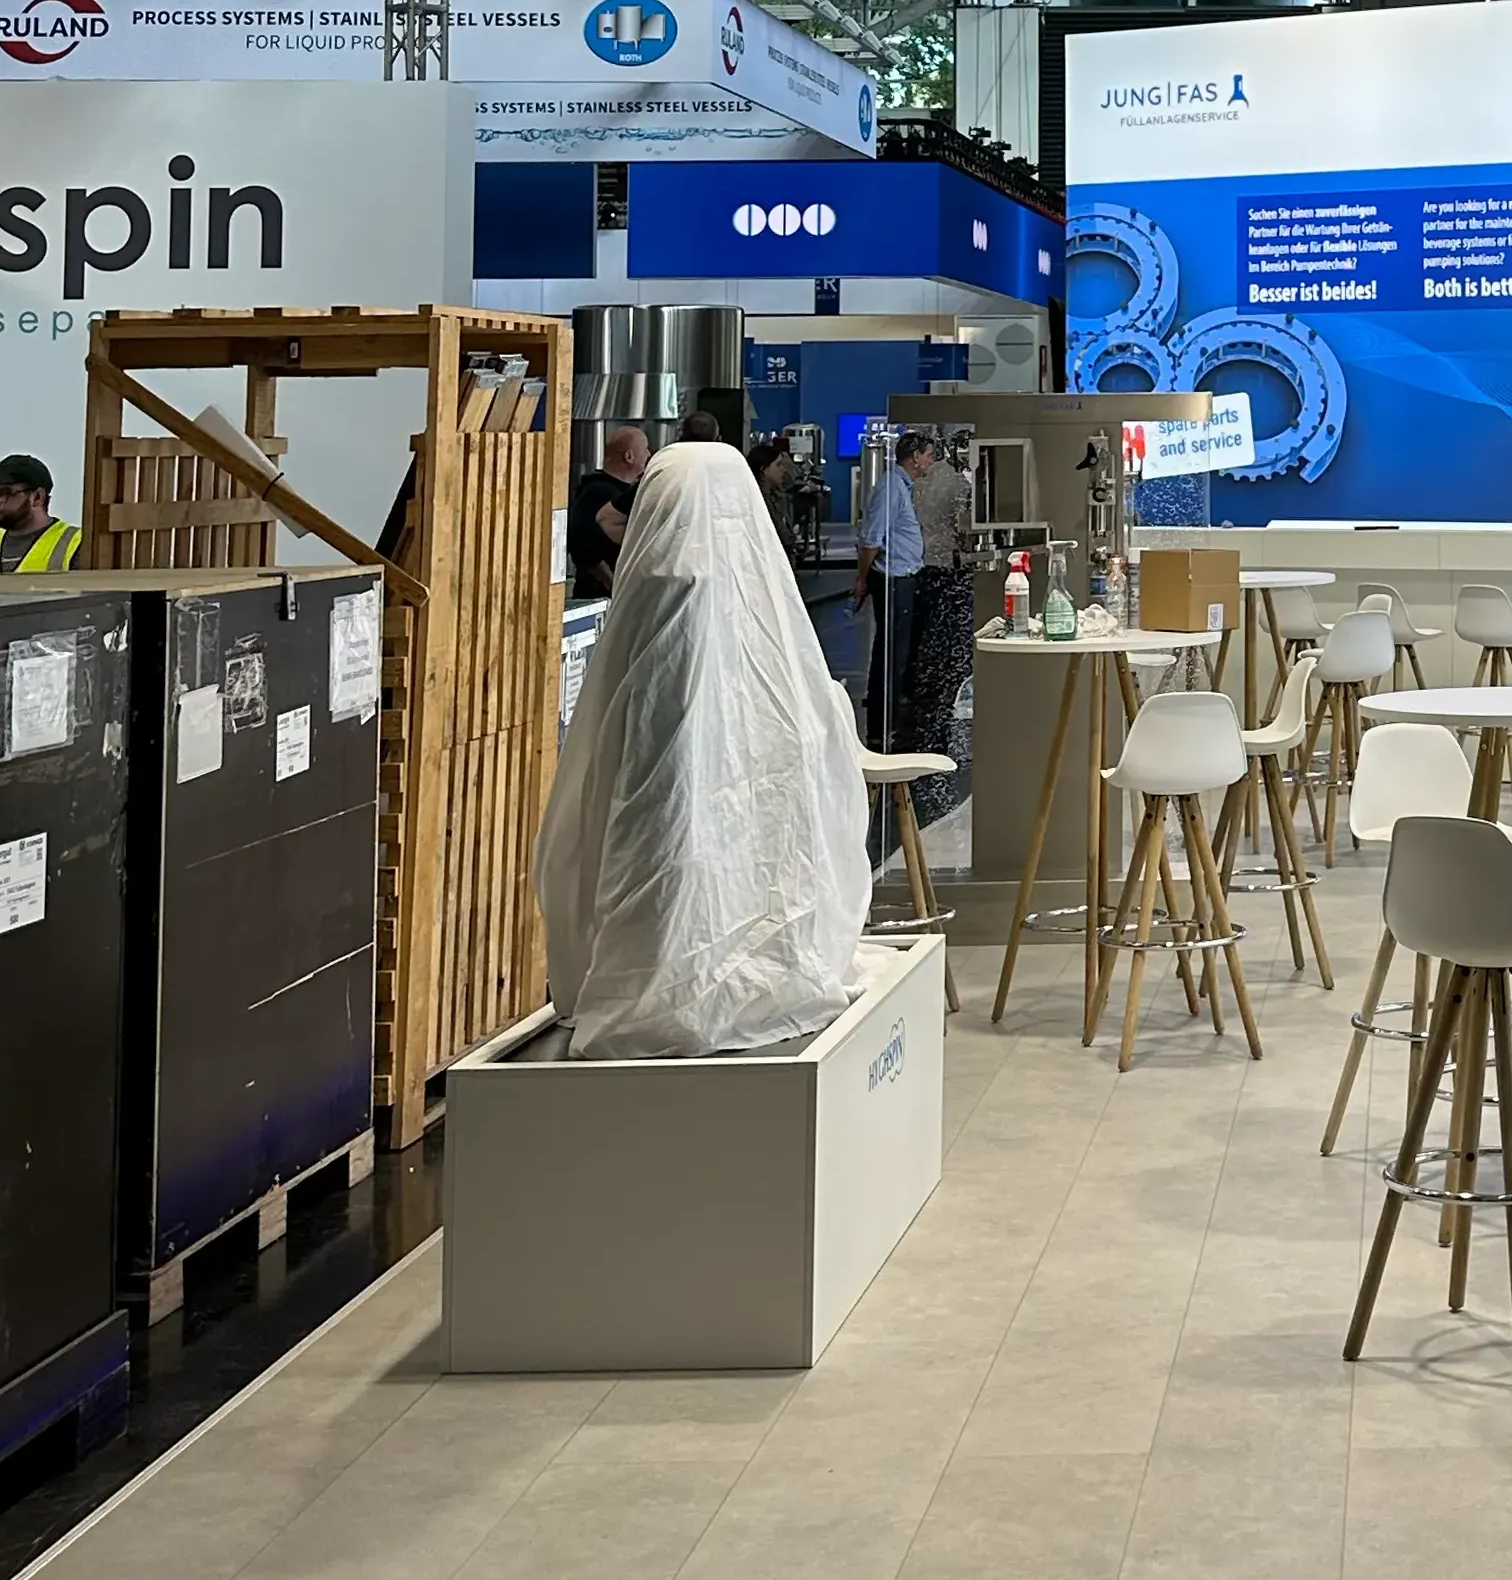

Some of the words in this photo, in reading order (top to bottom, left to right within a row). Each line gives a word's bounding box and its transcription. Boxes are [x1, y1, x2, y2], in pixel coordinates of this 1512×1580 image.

[132, 11, 216, 25] PROCESS
[222, 11, 304, 26] SYSTEMS
[319, 12, 421, 27] STAINLS
[482, 12, 561, 28] VESSELS
[246, 34, 280, 50] FOR
[286, 34, 346, 53] LIQUID
[491, 101, 556, 114] SYSTEMS
[567, 101, 643, 114] STAINLESS
[646, 101, 689, 113] STEEL
[692, 100, 753, 113] VESSELS
[1423, 201, 1437, 213] Are
[1438, 202, 1454, 216] you
[1455, 199, 1487, 214] looking
[1488, 198, 1501, 211] for
[1423, 219, 1454, 234] partner
[1455, 217, 1468, 231] for
[1469, 217, 1483, 229] the
[1423, 237, 1461, 251] beverage
[1462, 236, 1496, 250] systems
[1497, 235, 1507, 247] or
[1249, 283, 1298, 303] Besser
[1300, 281, 1320, 301] ist
[1321, 279, 1378, 301] beides!
[1423, 277, 1462, 299] Both
[1465, 276, 1478, 297] is
[1160, 437, 1186, 457] and
[1191, 432, 1243, 453] service
